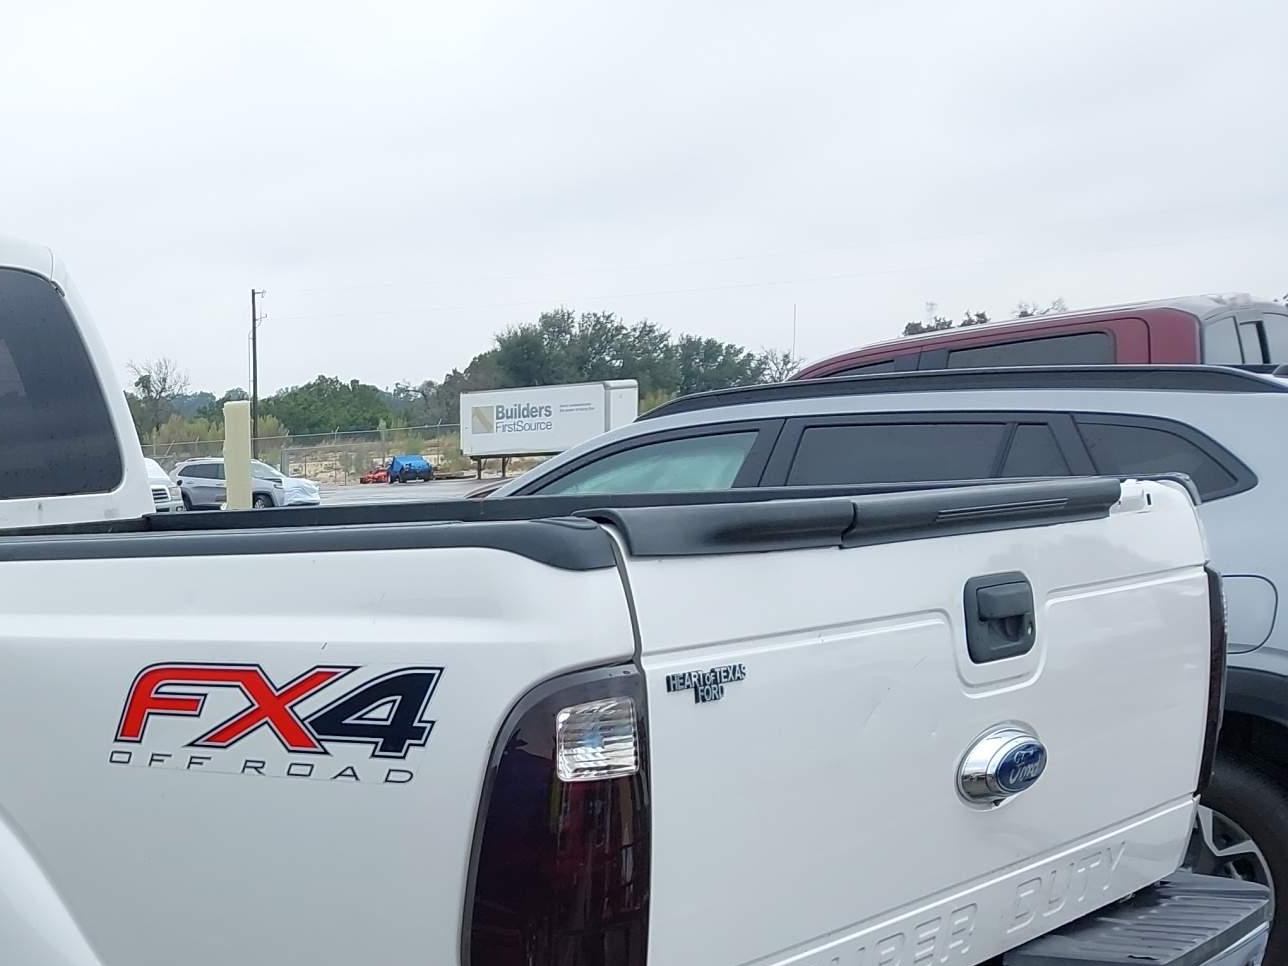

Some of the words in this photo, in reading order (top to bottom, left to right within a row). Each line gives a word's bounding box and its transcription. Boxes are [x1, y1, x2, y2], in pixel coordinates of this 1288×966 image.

[496, 403, 552, 420] Builders
[496, 420, 552, 433] FirstSource
[669, 671, 704, 692] HEART
[714, 664, 747, 683] TEXAS
[697, 684, 724, 703] FORD
[113, 661, 445, 759] FX4
[109, 751, 212, 769] OFF
[241, 759, 414, 784] ROAD
[1009, 749, 1042, 785] Ford
[1006, 840, 1126, 934] DUTY
